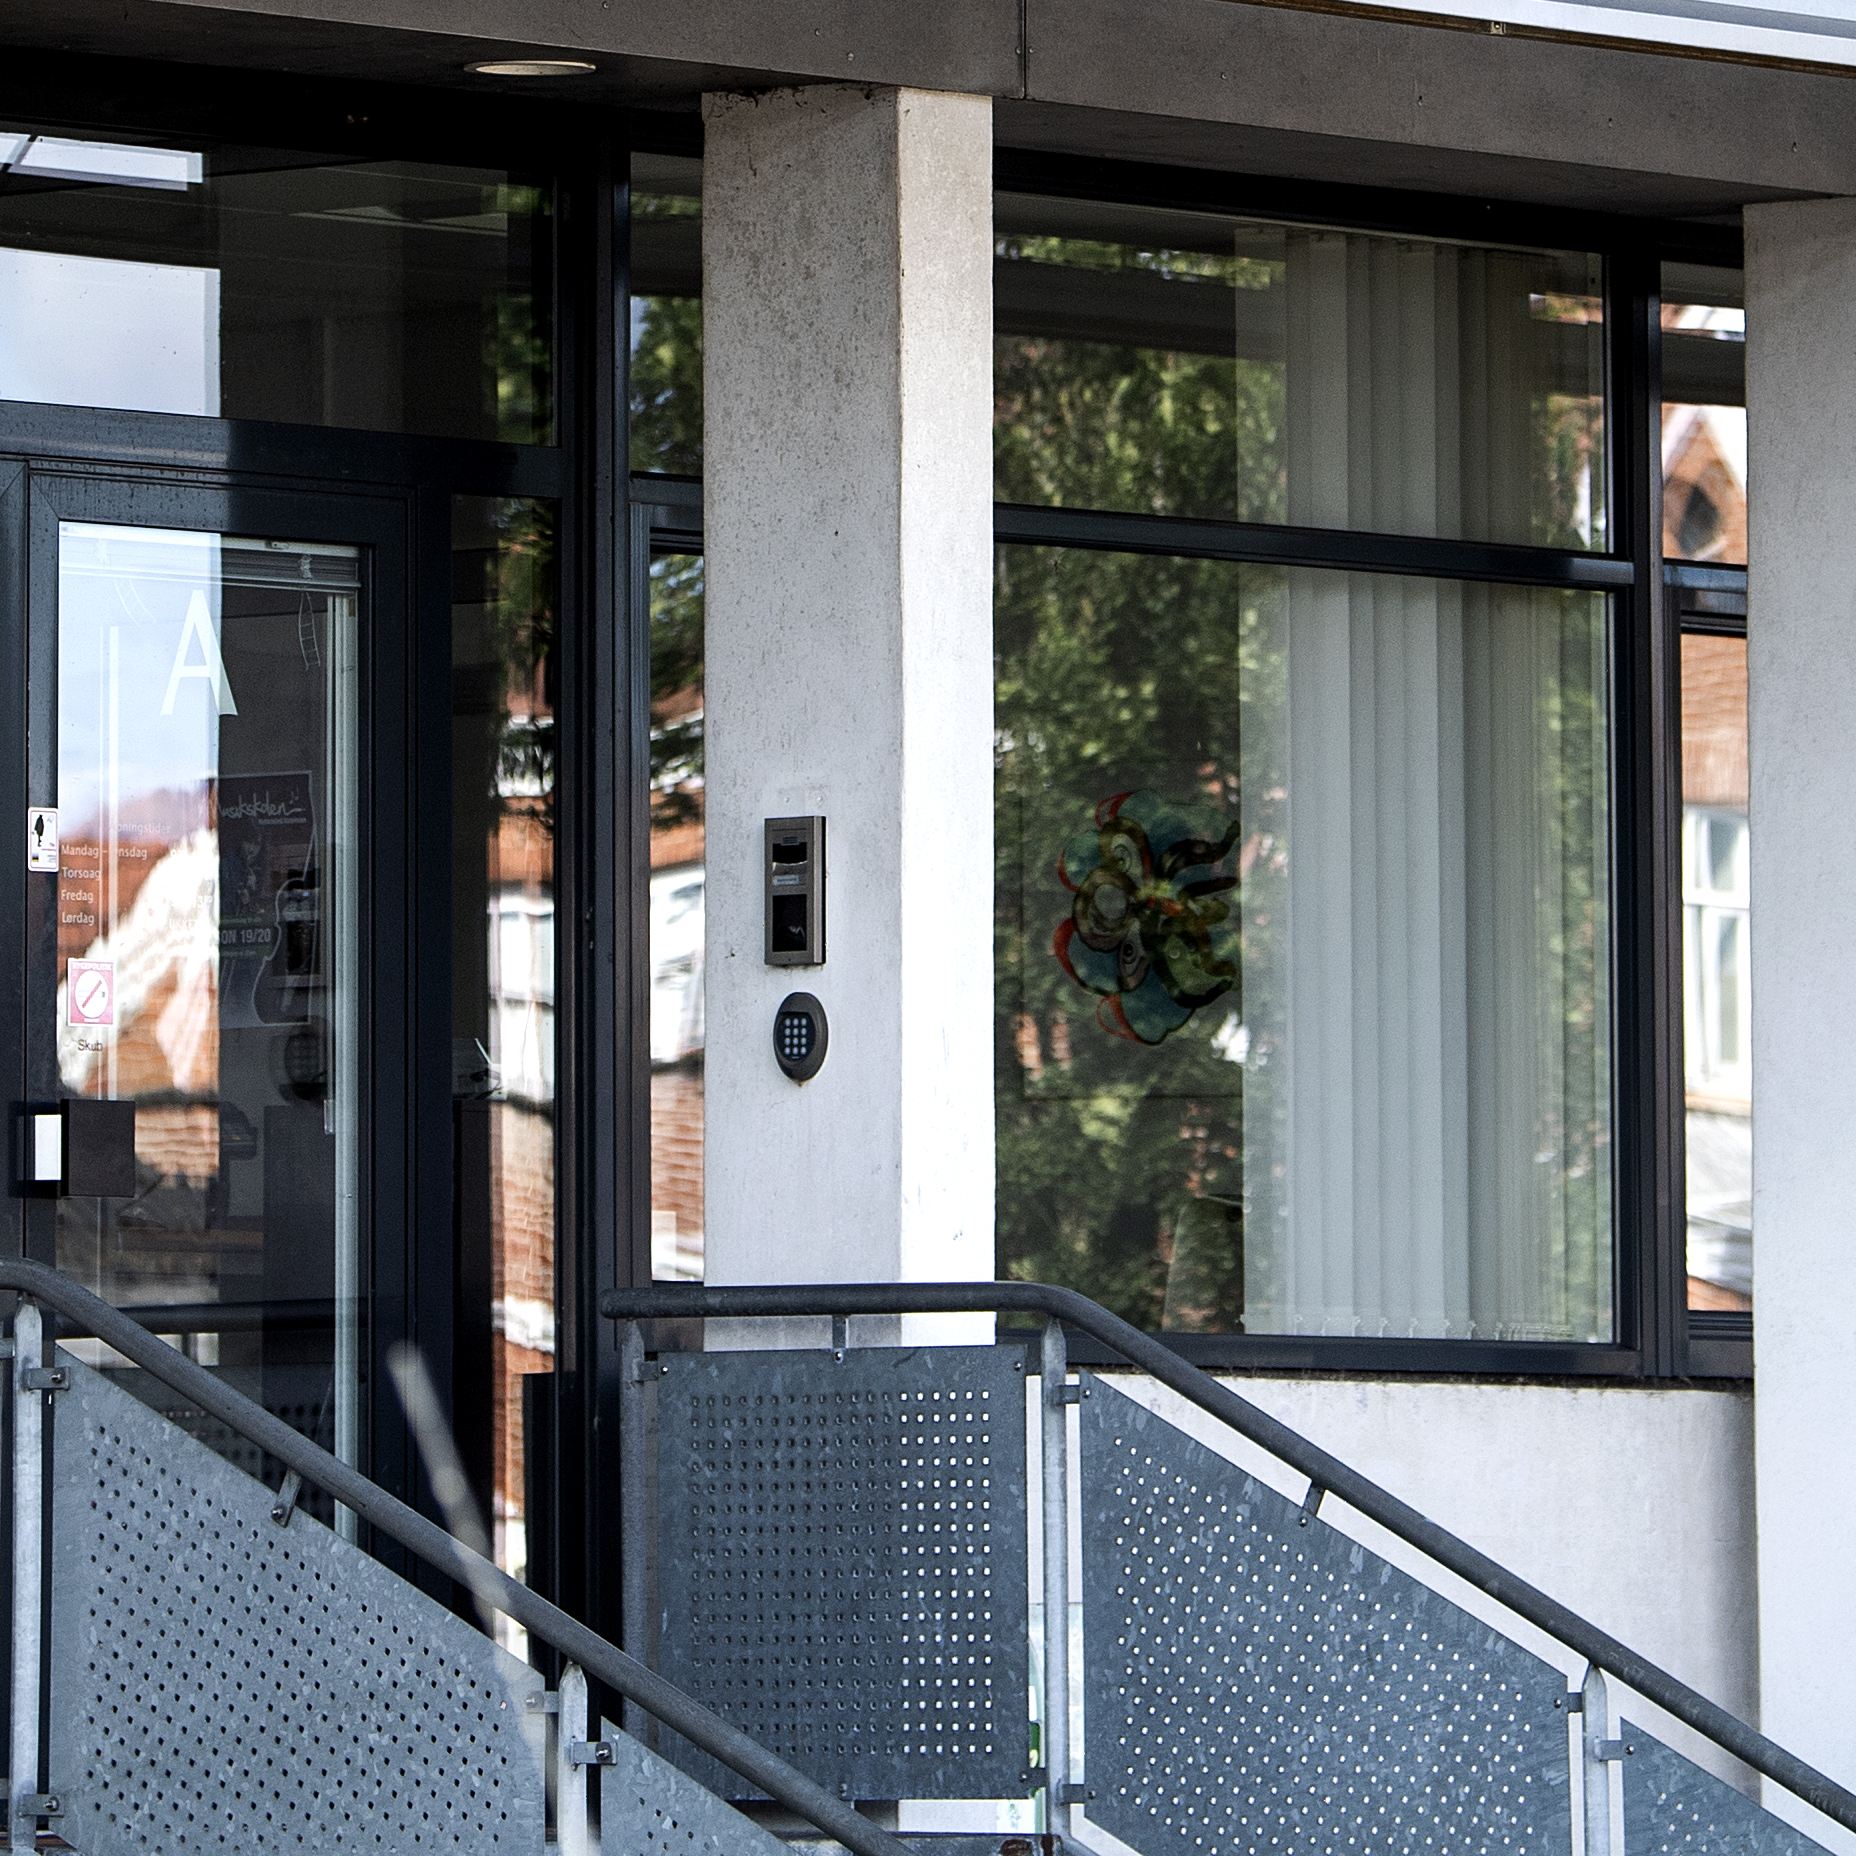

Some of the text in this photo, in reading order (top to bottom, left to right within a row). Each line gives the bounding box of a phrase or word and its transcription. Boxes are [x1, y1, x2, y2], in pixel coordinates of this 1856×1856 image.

[160, 589, 239, 716] A
[61, 844, 99, 859] Mandag
[117, 846, 148, 861] nsdag
[61, 866, 101, 882] Torsdag
[61, 889, 94, 905] Fredag
[61, 912, 95, 927] Lørdag
[240, 927, 272, 944] 19/20
[77, 1038, 103, 1052] Skub
